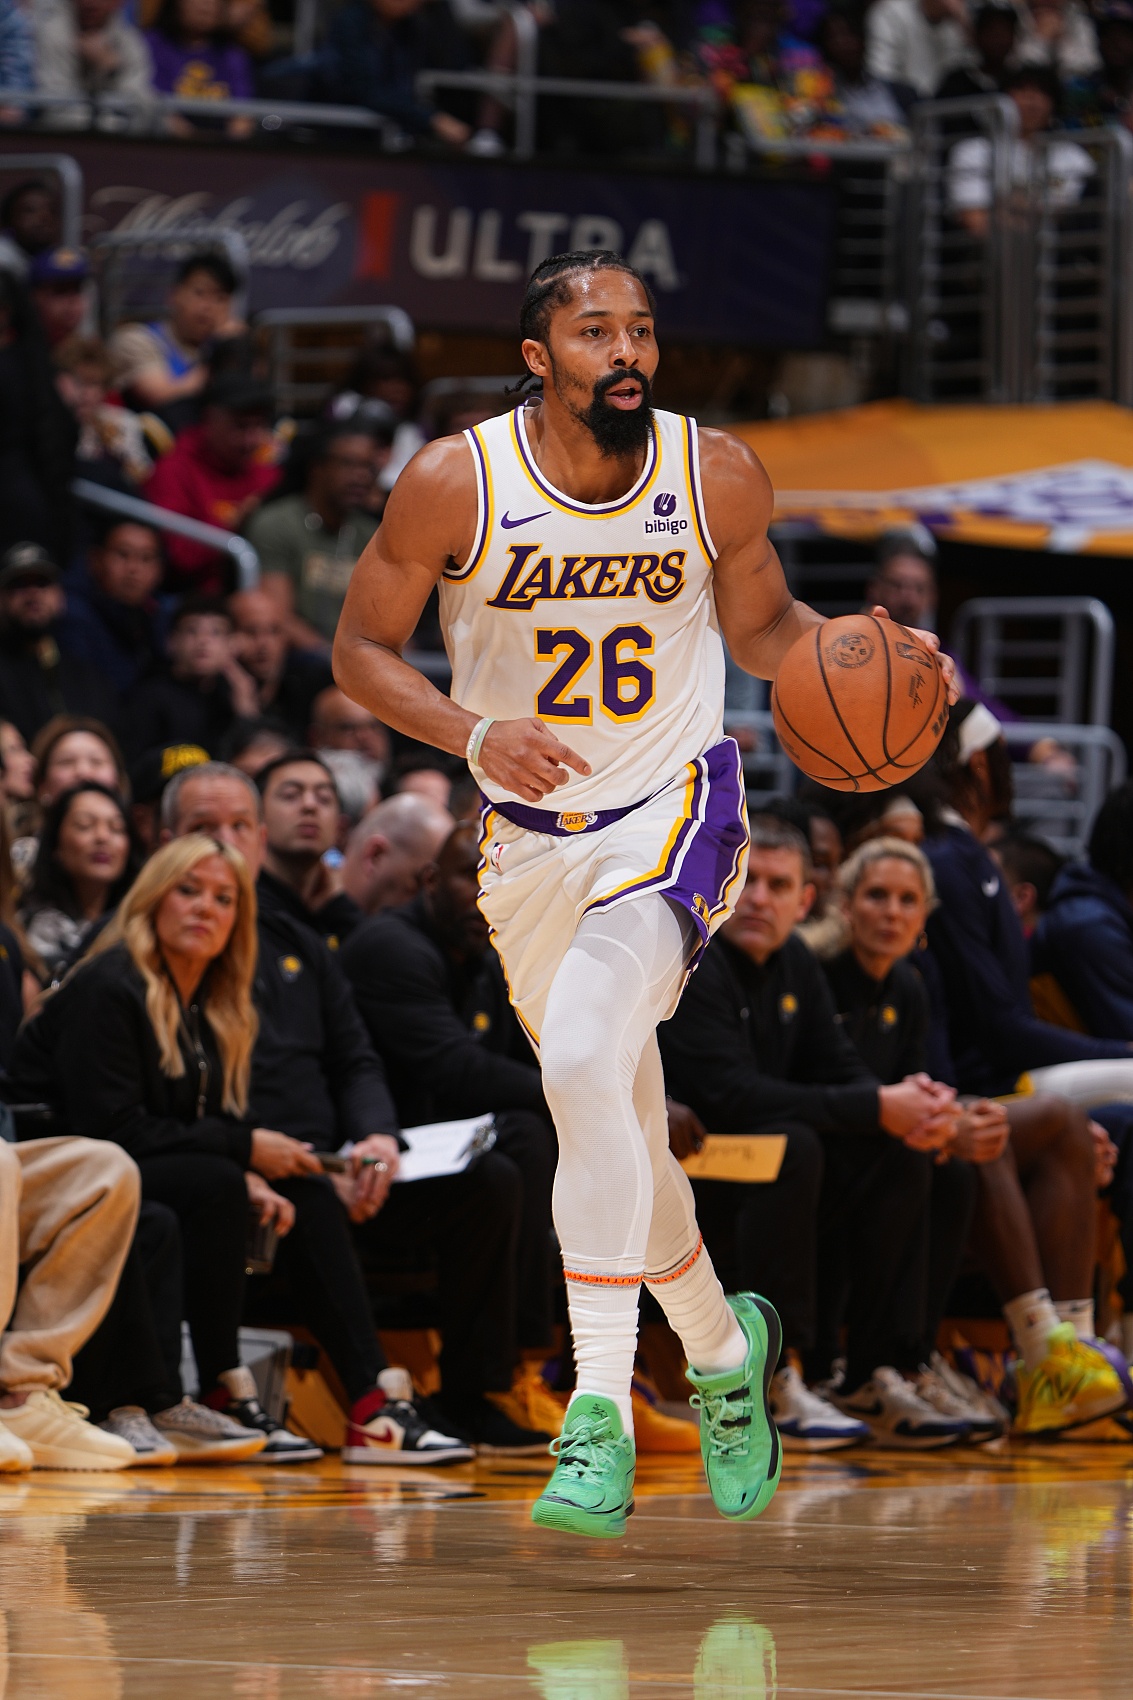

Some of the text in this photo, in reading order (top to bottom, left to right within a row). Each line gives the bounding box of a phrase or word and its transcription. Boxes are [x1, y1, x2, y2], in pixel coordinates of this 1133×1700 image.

[409, 204, 681, 291] ULTRA
[645, 518, 688, 535] bibigo
[484, 543, 688, 612] LAKERS
[534, 622, 656, 726] 26
[559, 812, 597, 827] LAKERS
